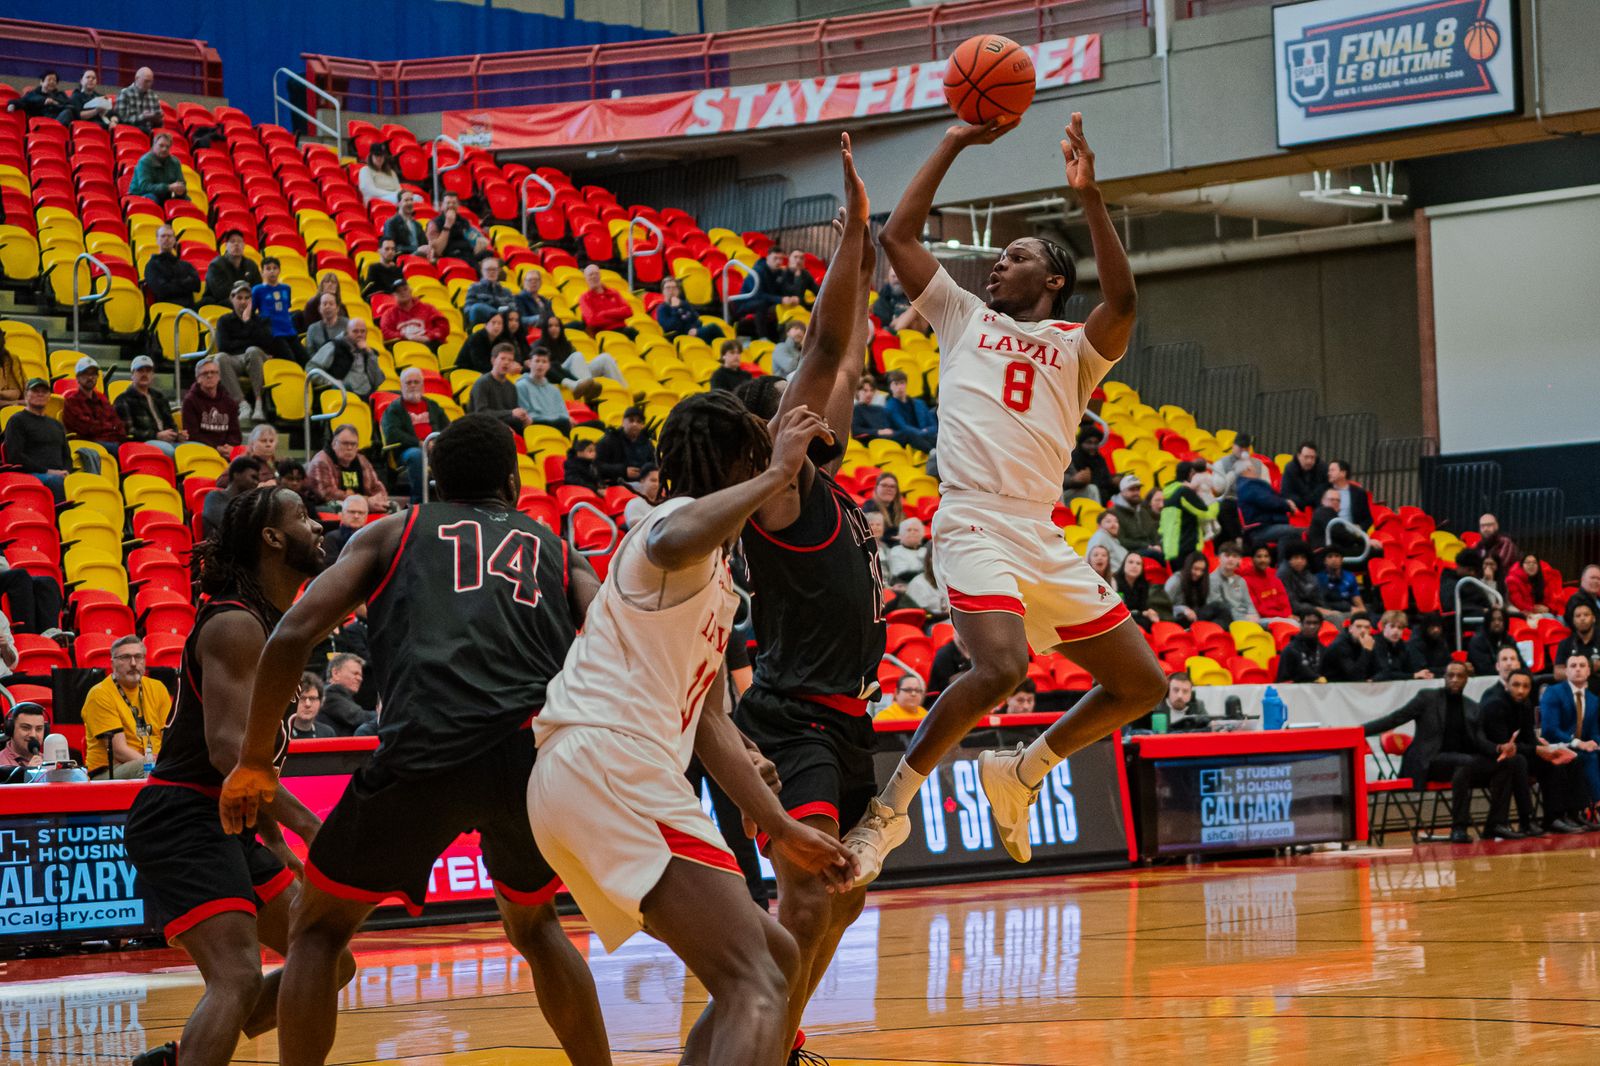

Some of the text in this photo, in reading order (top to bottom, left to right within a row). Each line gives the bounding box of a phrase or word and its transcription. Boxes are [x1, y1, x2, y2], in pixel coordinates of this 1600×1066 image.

[1339, 17, 1459, 65] FINAL 8
[685, 34, 1089, 136] STAY FIEE!
[1335, 48, 1454, 85] LE 8 ULTIME
[978, 333, 1061, 370] LAVAL
[1002, 361, 1036, 413] 8
[438, 519, 542, 608] 14
[1235, 766, 1292, 780] STUDENT
[1236, 780, 1292, 793] HOUSING
[1201, 792, 1293, 826] CALGARY
[38, 825, 126, 844] STUDEN
[39, 843, 129, 863] HOUSIN
[0, 860, 138, 907] ALGARY
